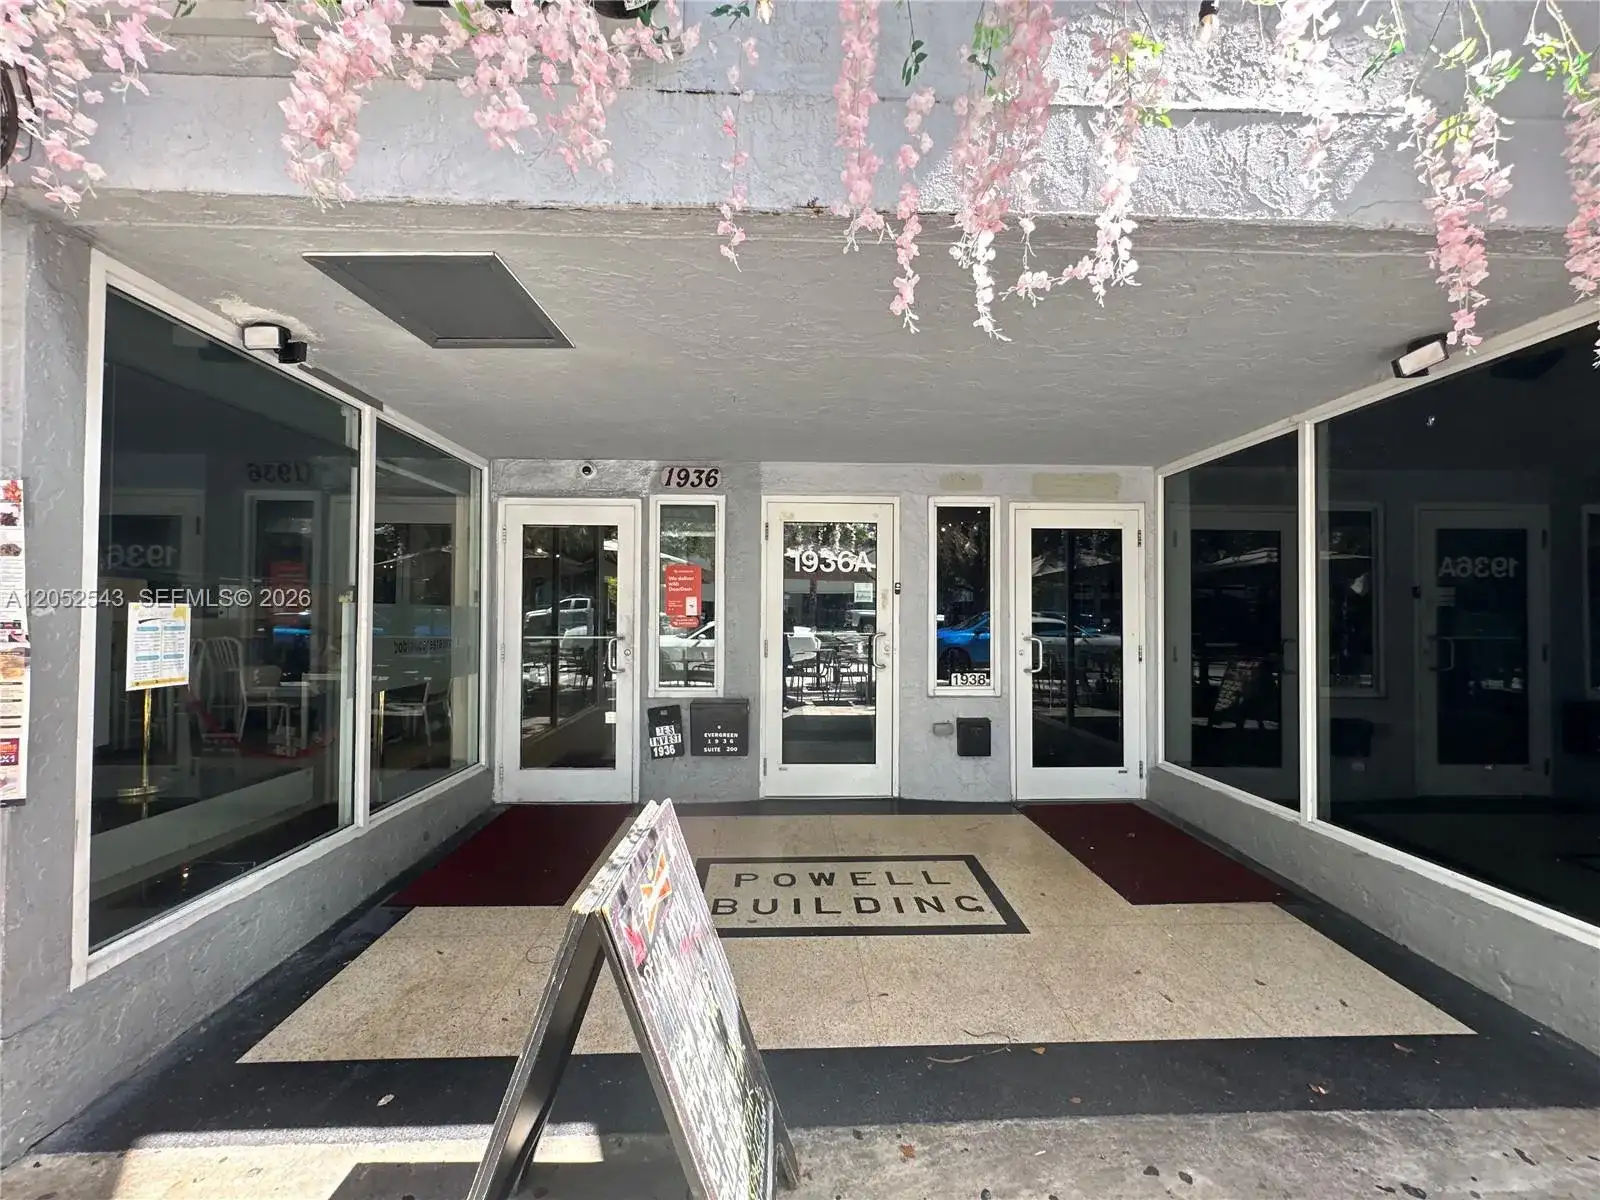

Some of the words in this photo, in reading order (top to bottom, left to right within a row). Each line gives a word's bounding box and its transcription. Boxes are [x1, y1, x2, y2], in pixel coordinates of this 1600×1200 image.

[664, 467, 719, 488] 1936
[790, 550, 873, 573] 1936A
[953, 674, 986, 685] 1938
[650, 733, 681, 746] INVEST
[653, 744, 676, 757] 1936
[734, 871, 951, 888] POWELL
[711, 896, 985, 915] BUILDING
